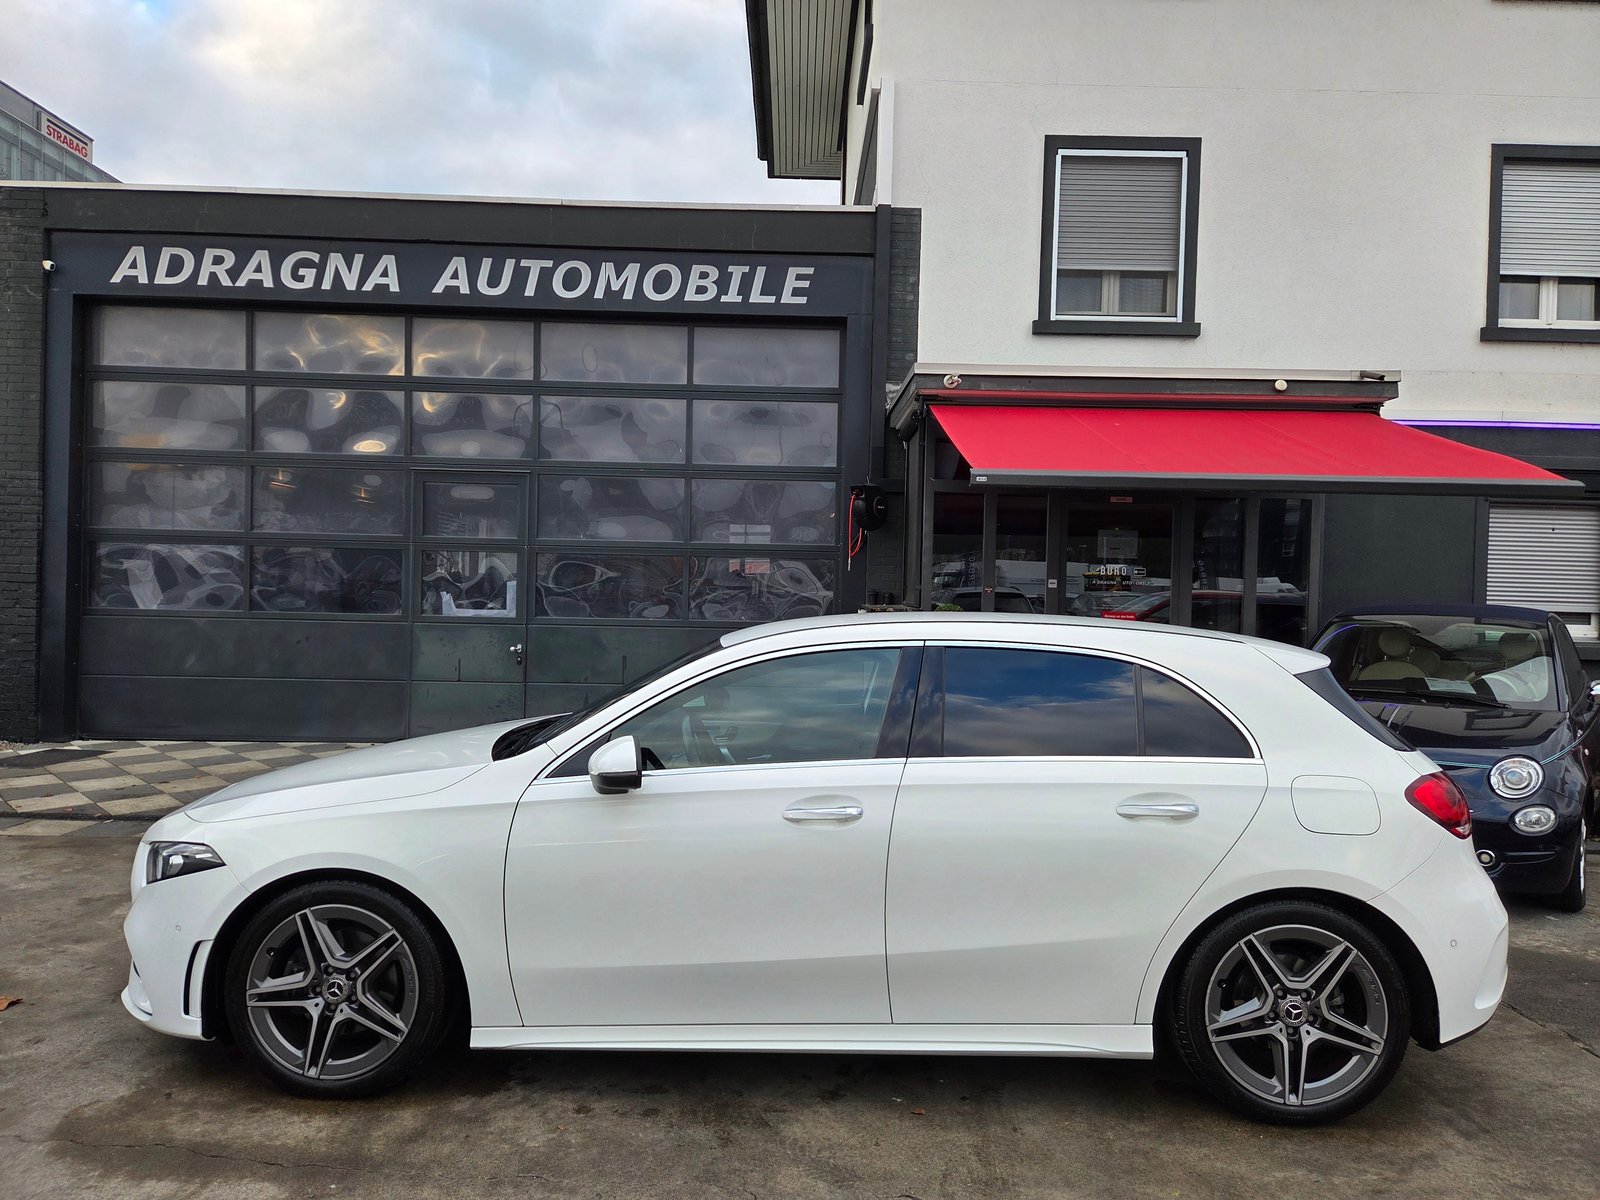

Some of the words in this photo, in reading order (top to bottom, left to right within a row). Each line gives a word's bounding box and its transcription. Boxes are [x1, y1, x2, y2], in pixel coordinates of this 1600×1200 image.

[46, 124, 88, 158] STRABAG
[109, 245, 401, 292] ADRAGNA
[431, 256, 815, 304] AUTOMOBILE
